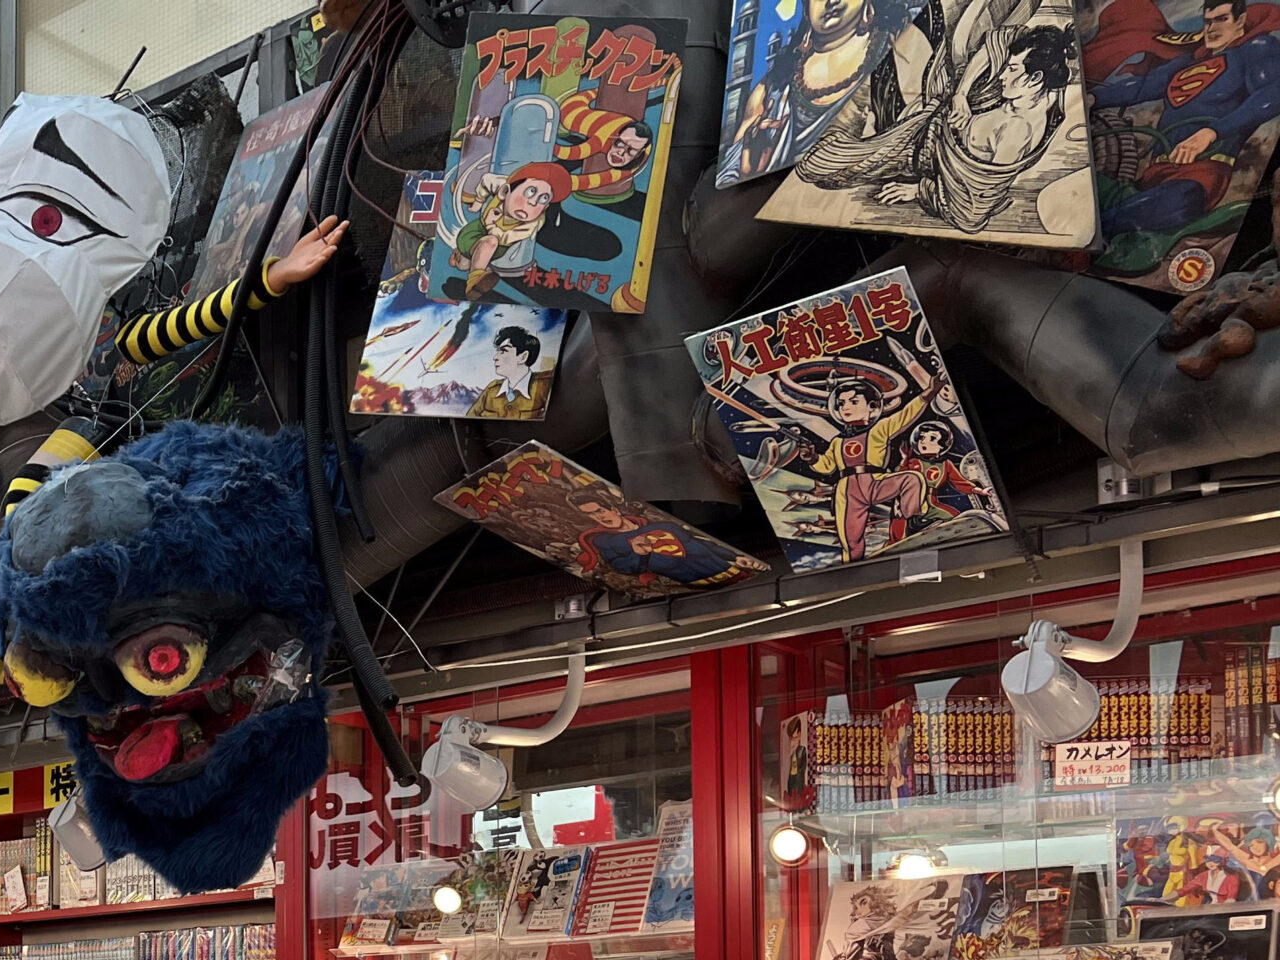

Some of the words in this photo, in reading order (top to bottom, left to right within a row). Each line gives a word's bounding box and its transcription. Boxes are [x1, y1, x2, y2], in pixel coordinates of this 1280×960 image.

[477, 26, 680, 92] プラスチックマン
[522, 266, 612, 294] 水木しげる
[1066, 745, 1131, 760] カメレオン
